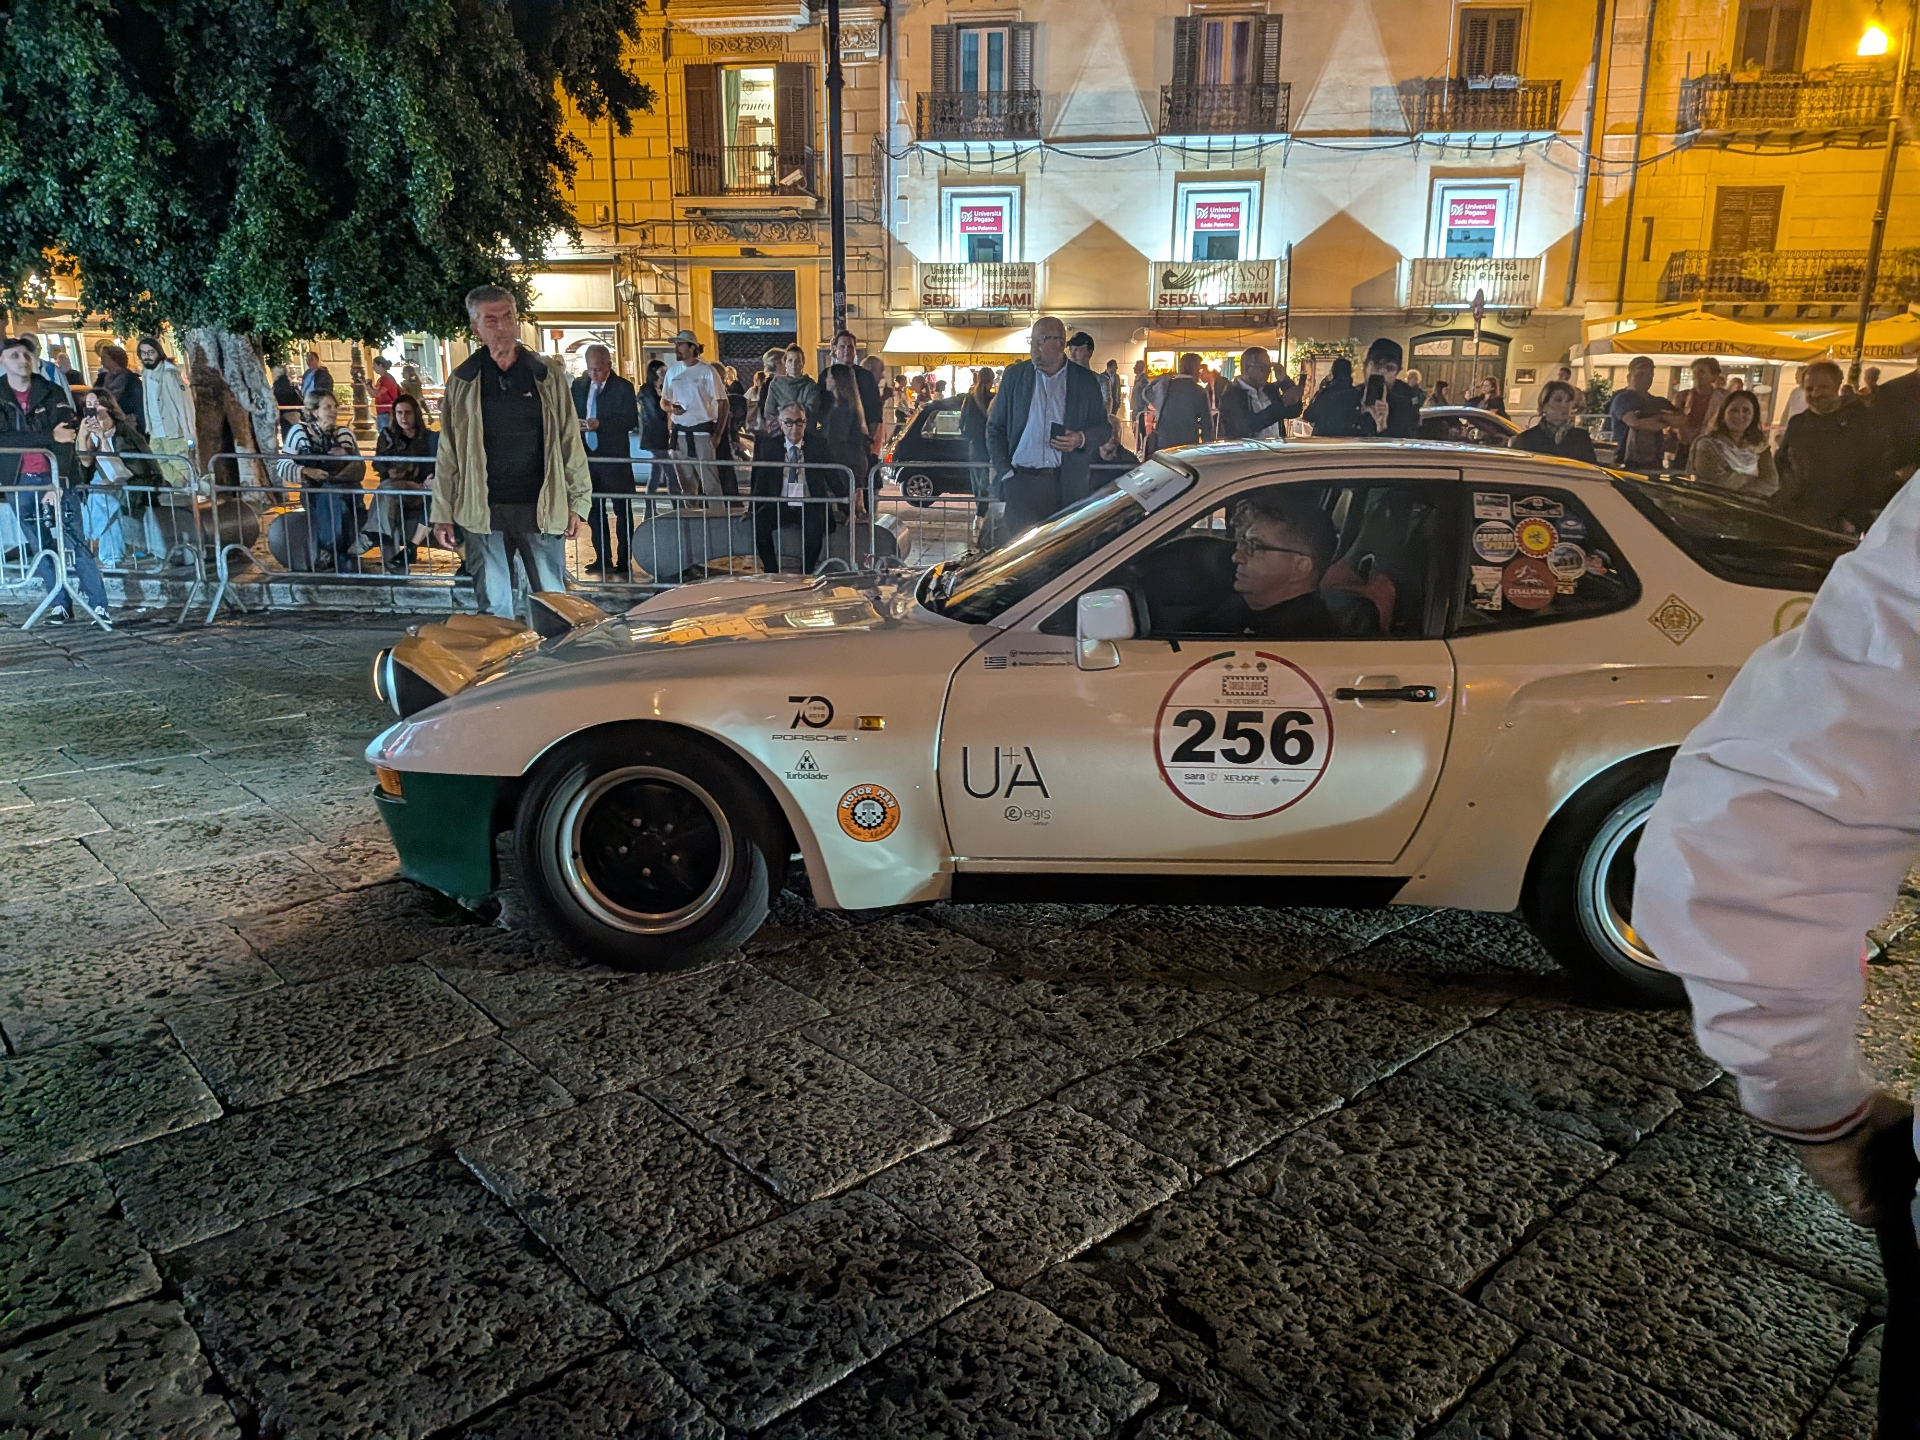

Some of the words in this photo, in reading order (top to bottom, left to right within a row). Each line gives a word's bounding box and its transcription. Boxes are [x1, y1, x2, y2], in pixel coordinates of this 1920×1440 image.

[1464, 209, 1488, 217] Pegaso
[930, 266, 964, 275] Università
[1453, 260, 1517, 271] Università
[1451, 271, 1476, 281] San
[1478, 271, 1530, 281] Raffaele
[922, 293, 960, 306] SEDE
[1158, 293, 1198, 305] SEDE
[728, 311, 752, 326] The
[755, 317, 780, 326] man
[1660, 341, 1735, 353] PASTICCERIA
[1839, 344, 1905, 356] CAETTERIA
[974, 354, 1005, 365] Veronica
[788, 695, 834, 729] 70
[1170, 709, 1315, 765] 256
[785, 771, 829, 780] Turbolader
[1223, 774, 1260, 782] XERJOFF
[841, 786, 872, 809] MOTOR
[876, 789, 896, 808] MAN
[1024, 807, 1053, 820] egis
